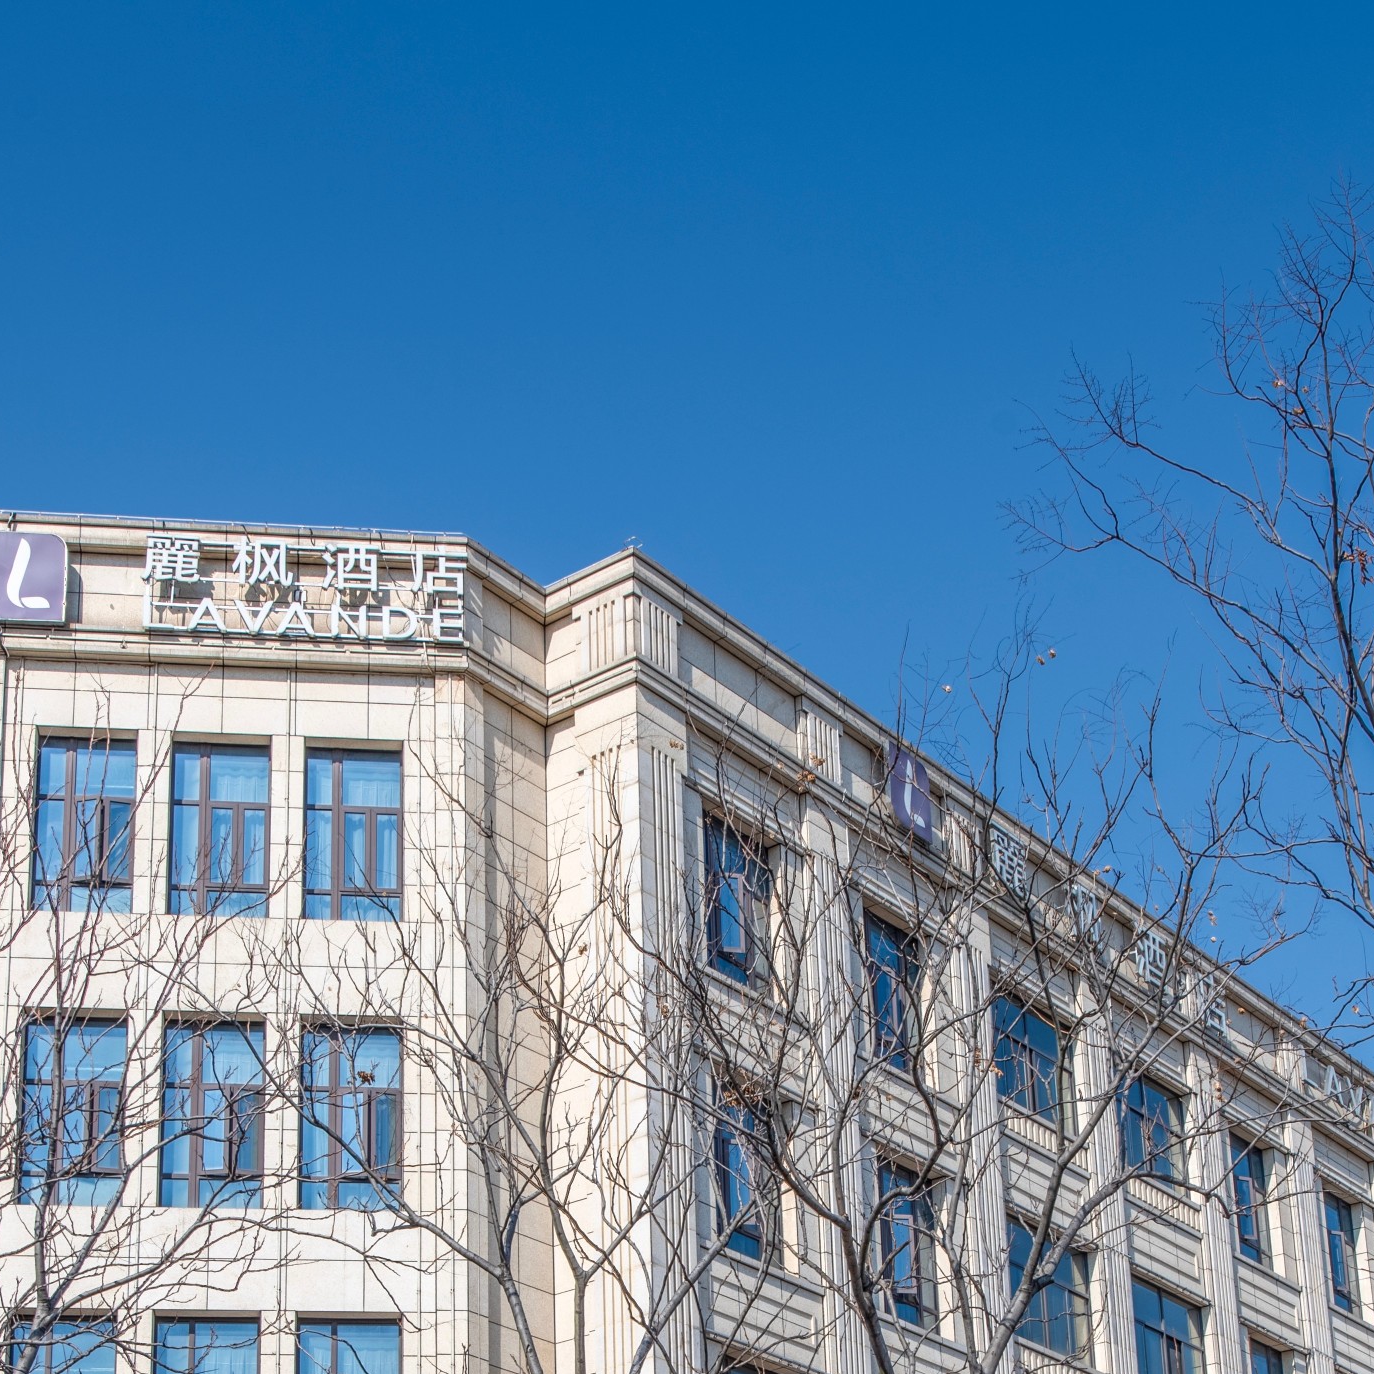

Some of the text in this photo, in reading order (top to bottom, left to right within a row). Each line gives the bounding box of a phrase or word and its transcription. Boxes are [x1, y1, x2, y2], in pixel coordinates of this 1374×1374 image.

[141, 534, 467, 596] 麗枫酒店
[143, 594, 464, 643] LAVANDE
